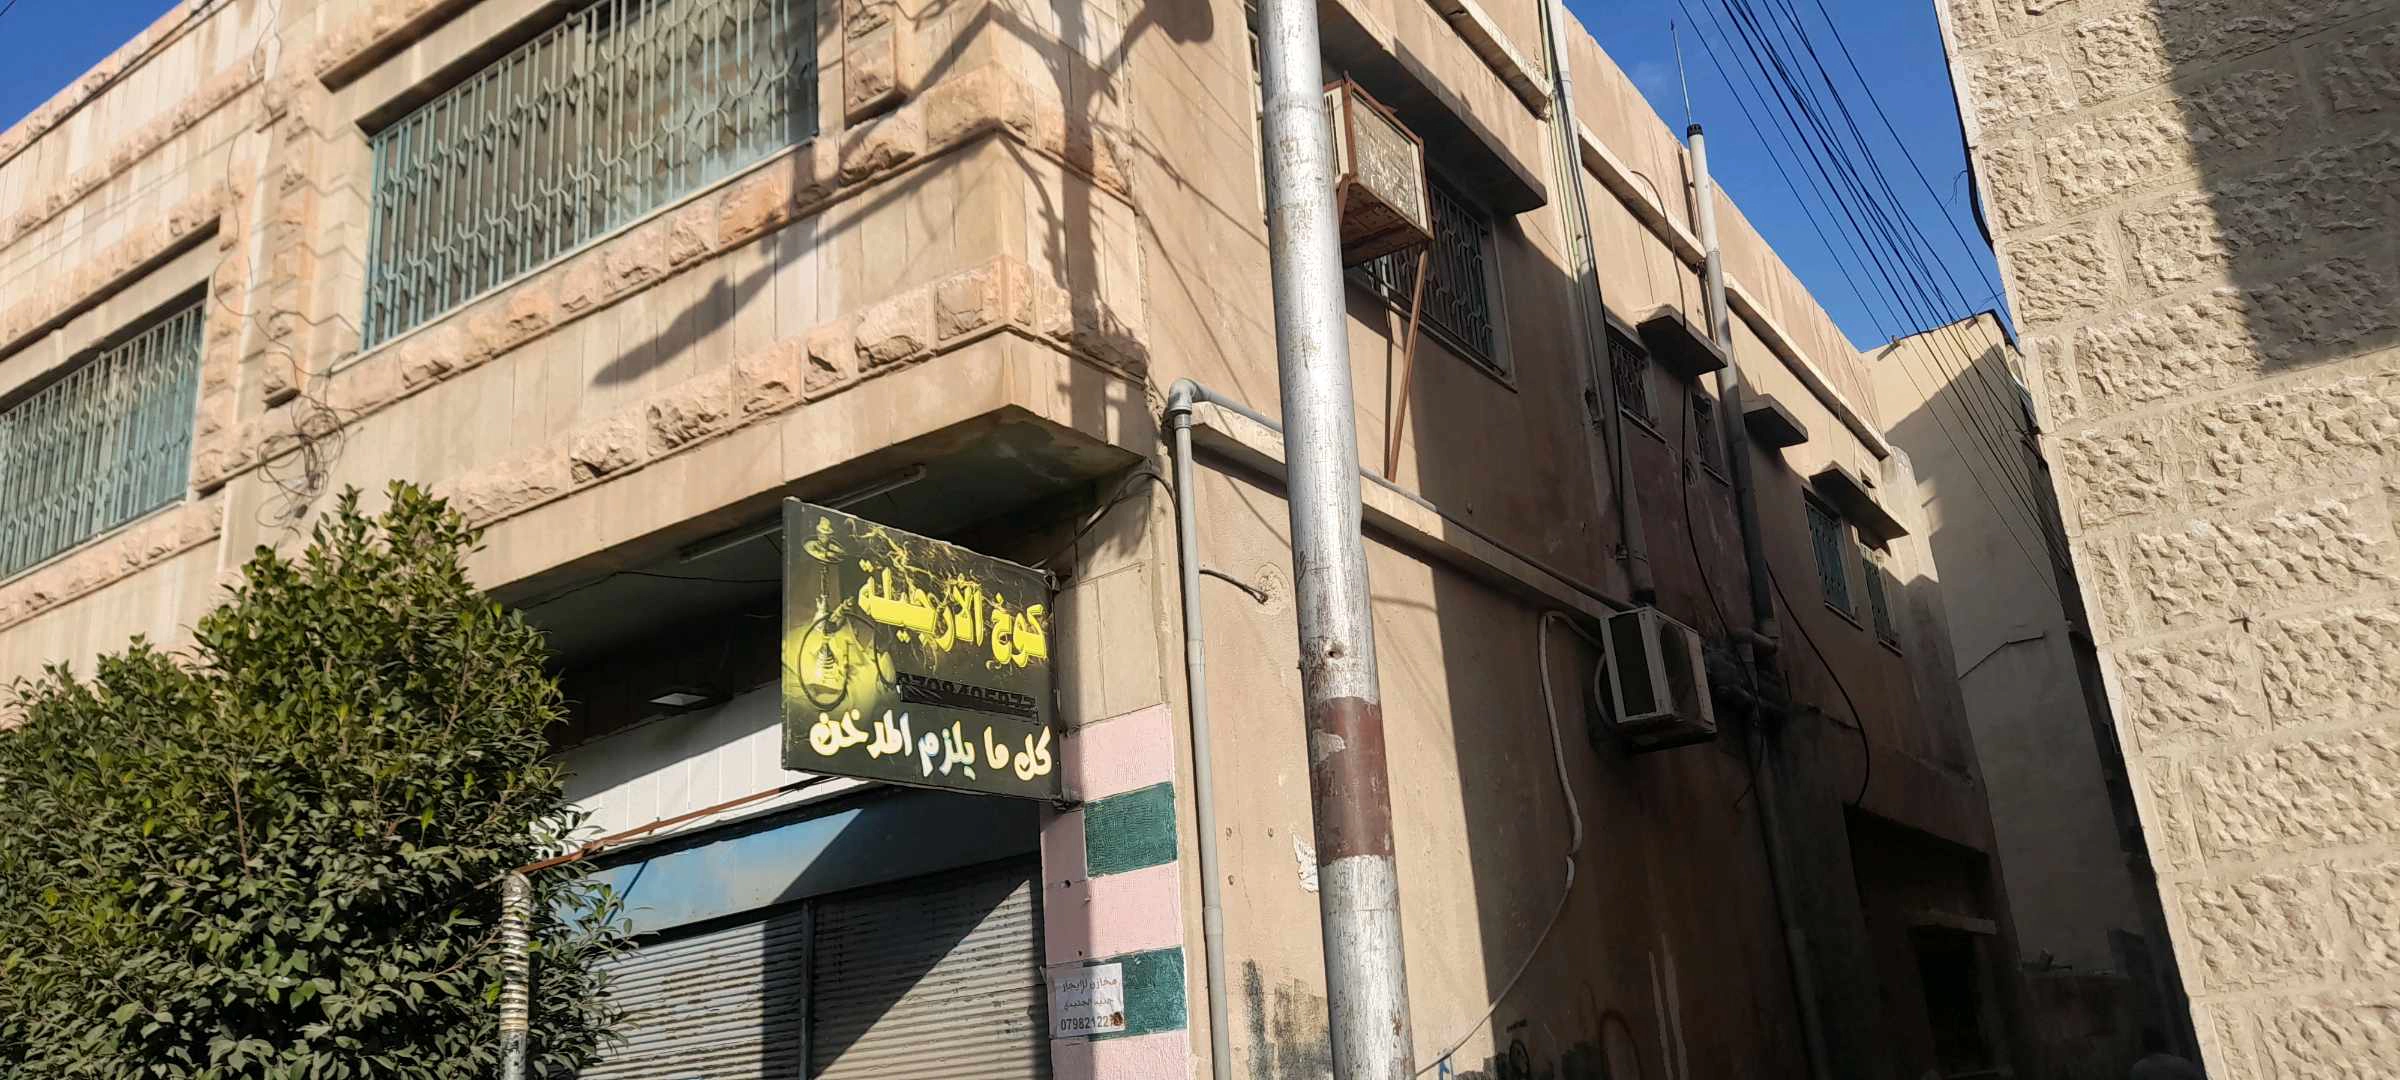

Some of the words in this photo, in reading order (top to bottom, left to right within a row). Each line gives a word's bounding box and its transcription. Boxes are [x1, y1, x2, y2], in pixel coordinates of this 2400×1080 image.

[991, 592, 1048, 668] كوخ
[809, 708, 913, 759] المدخن
[918, 720, 977, 781] يلزم
[983, 725, 1009, 770] ما
[1013, 725, 1052, 781] كل
[1060, 1013, 1122, 1031] 07982122
